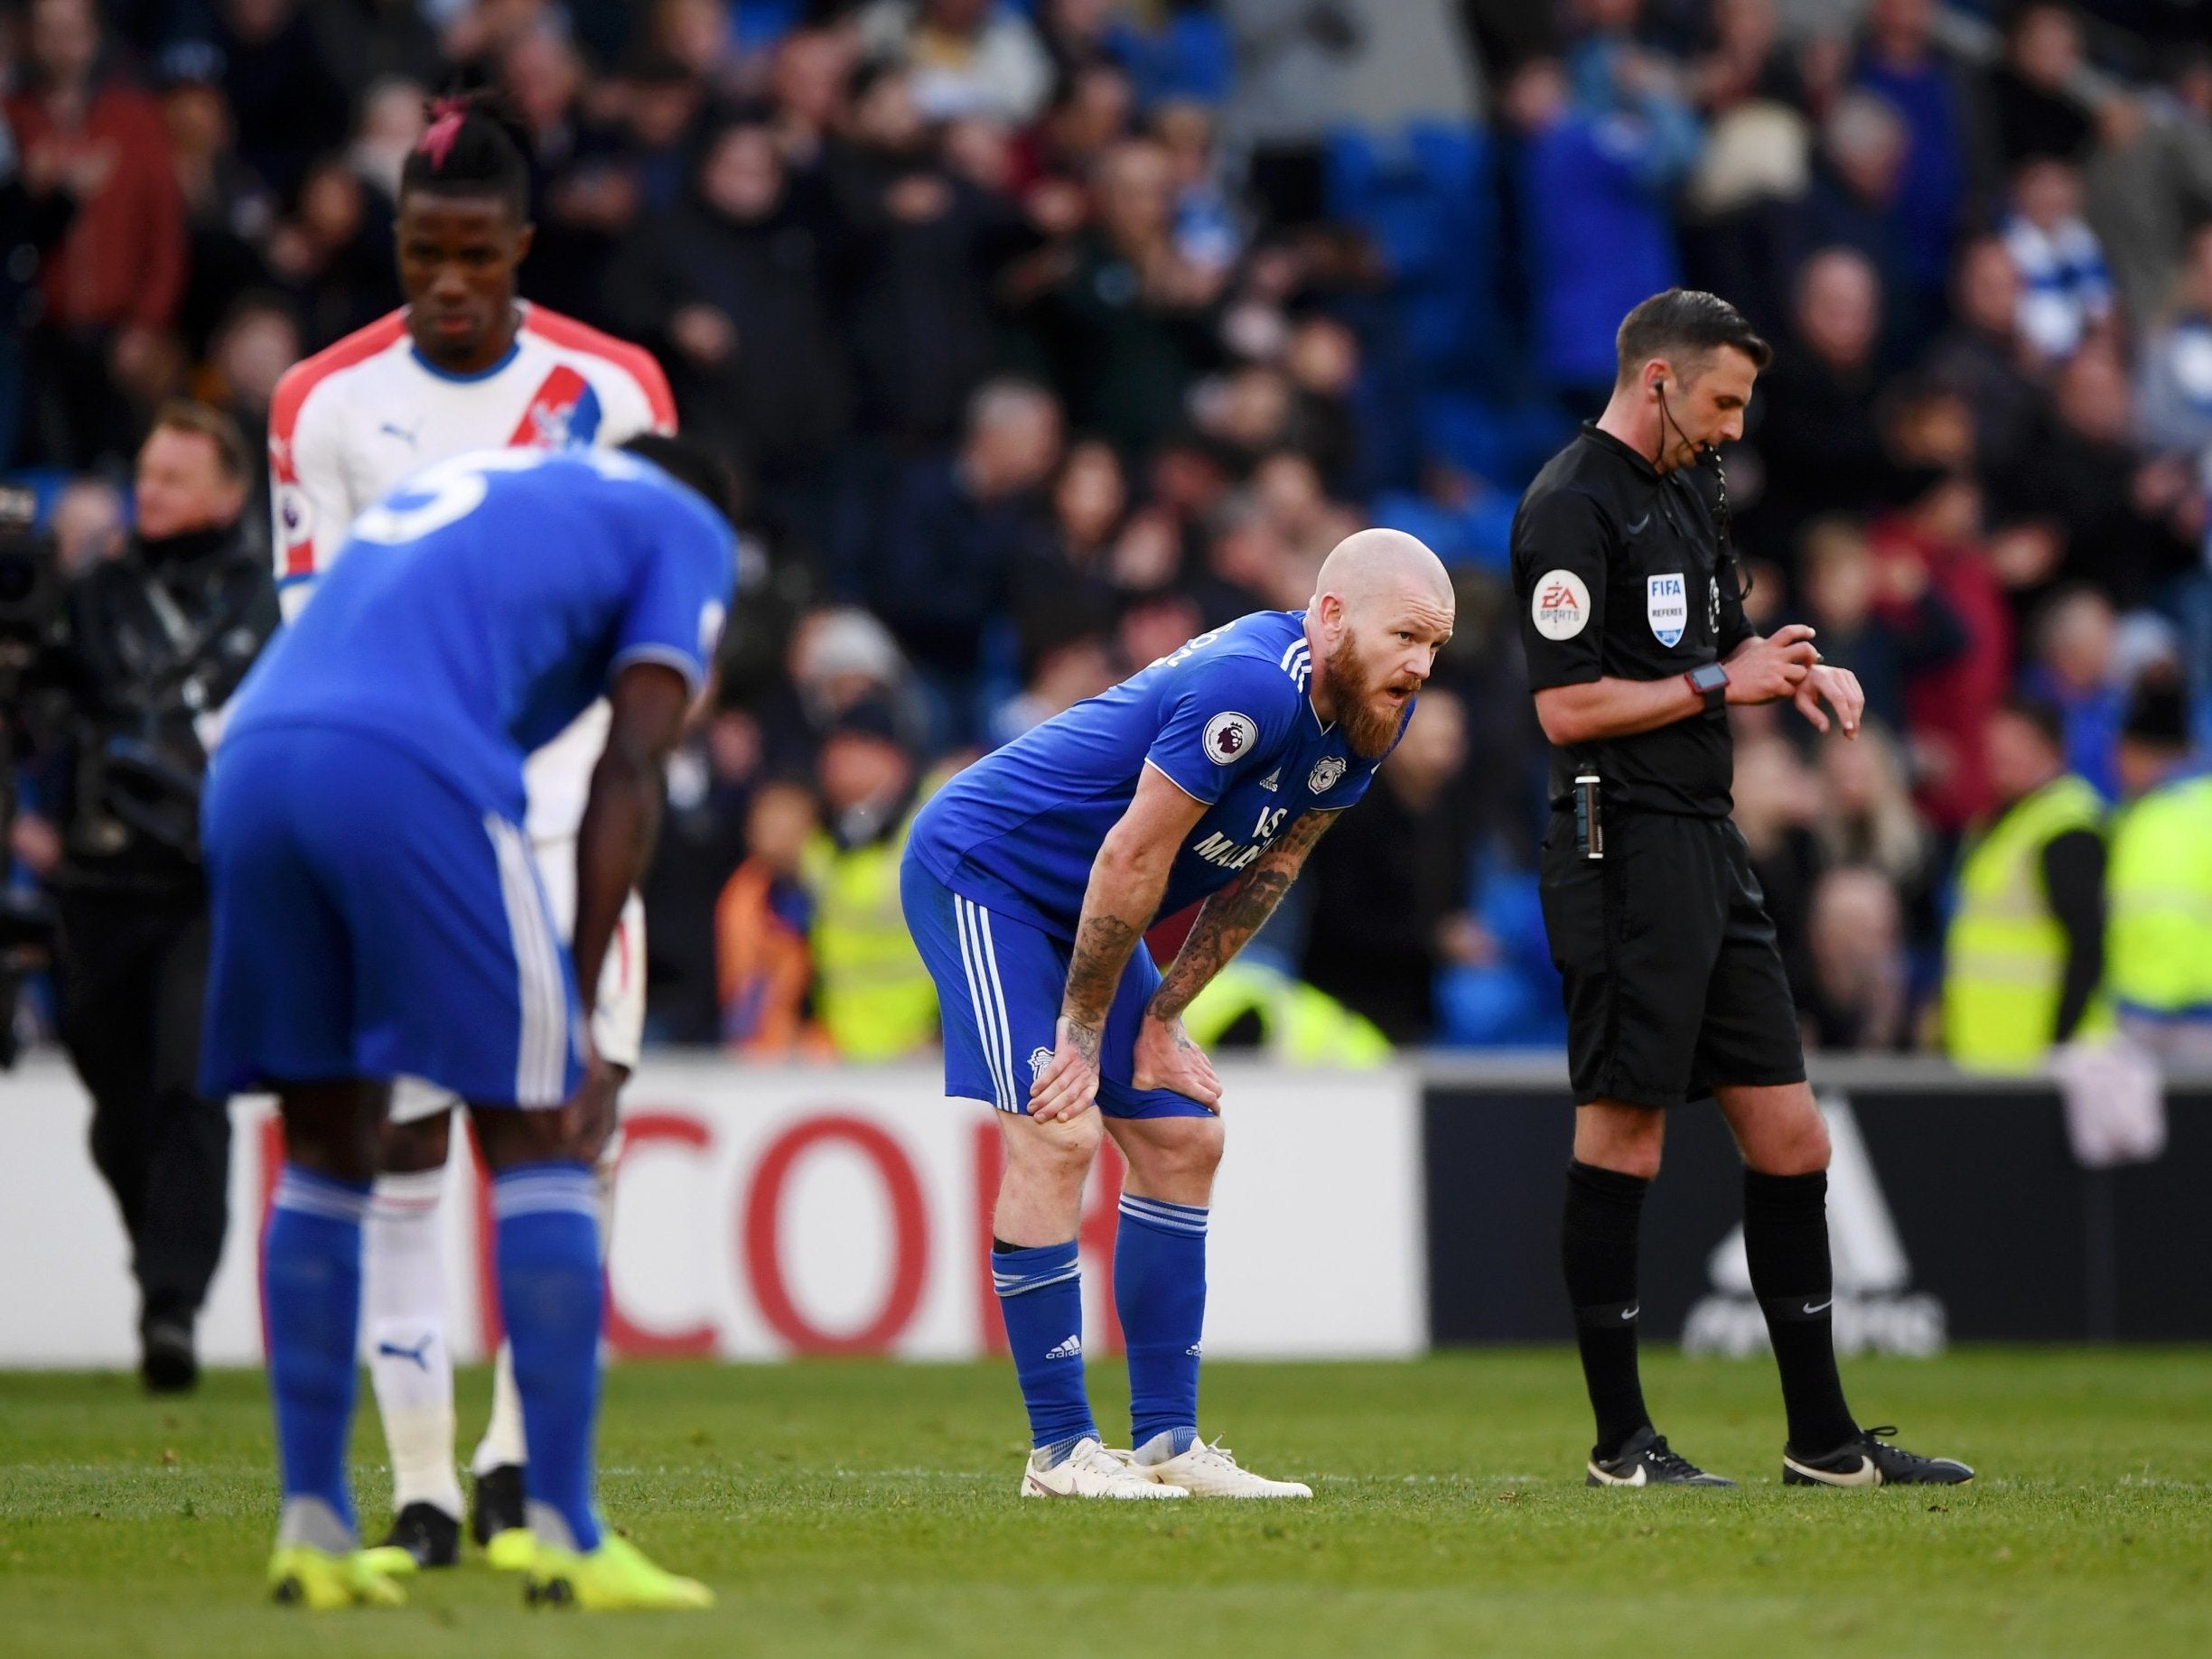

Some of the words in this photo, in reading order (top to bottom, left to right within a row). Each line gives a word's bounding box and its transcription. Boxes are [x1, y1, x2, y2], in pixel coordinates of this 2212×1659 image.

[1651, 580, 1681, 596] FIFA
[1541, 586, 1579, 609] EA
[1540, 610, 1580, 621] SPORTS
[1652, 607, 1683, 617] REFEREE
[258, 1114, 1125, 1358] ICOH
